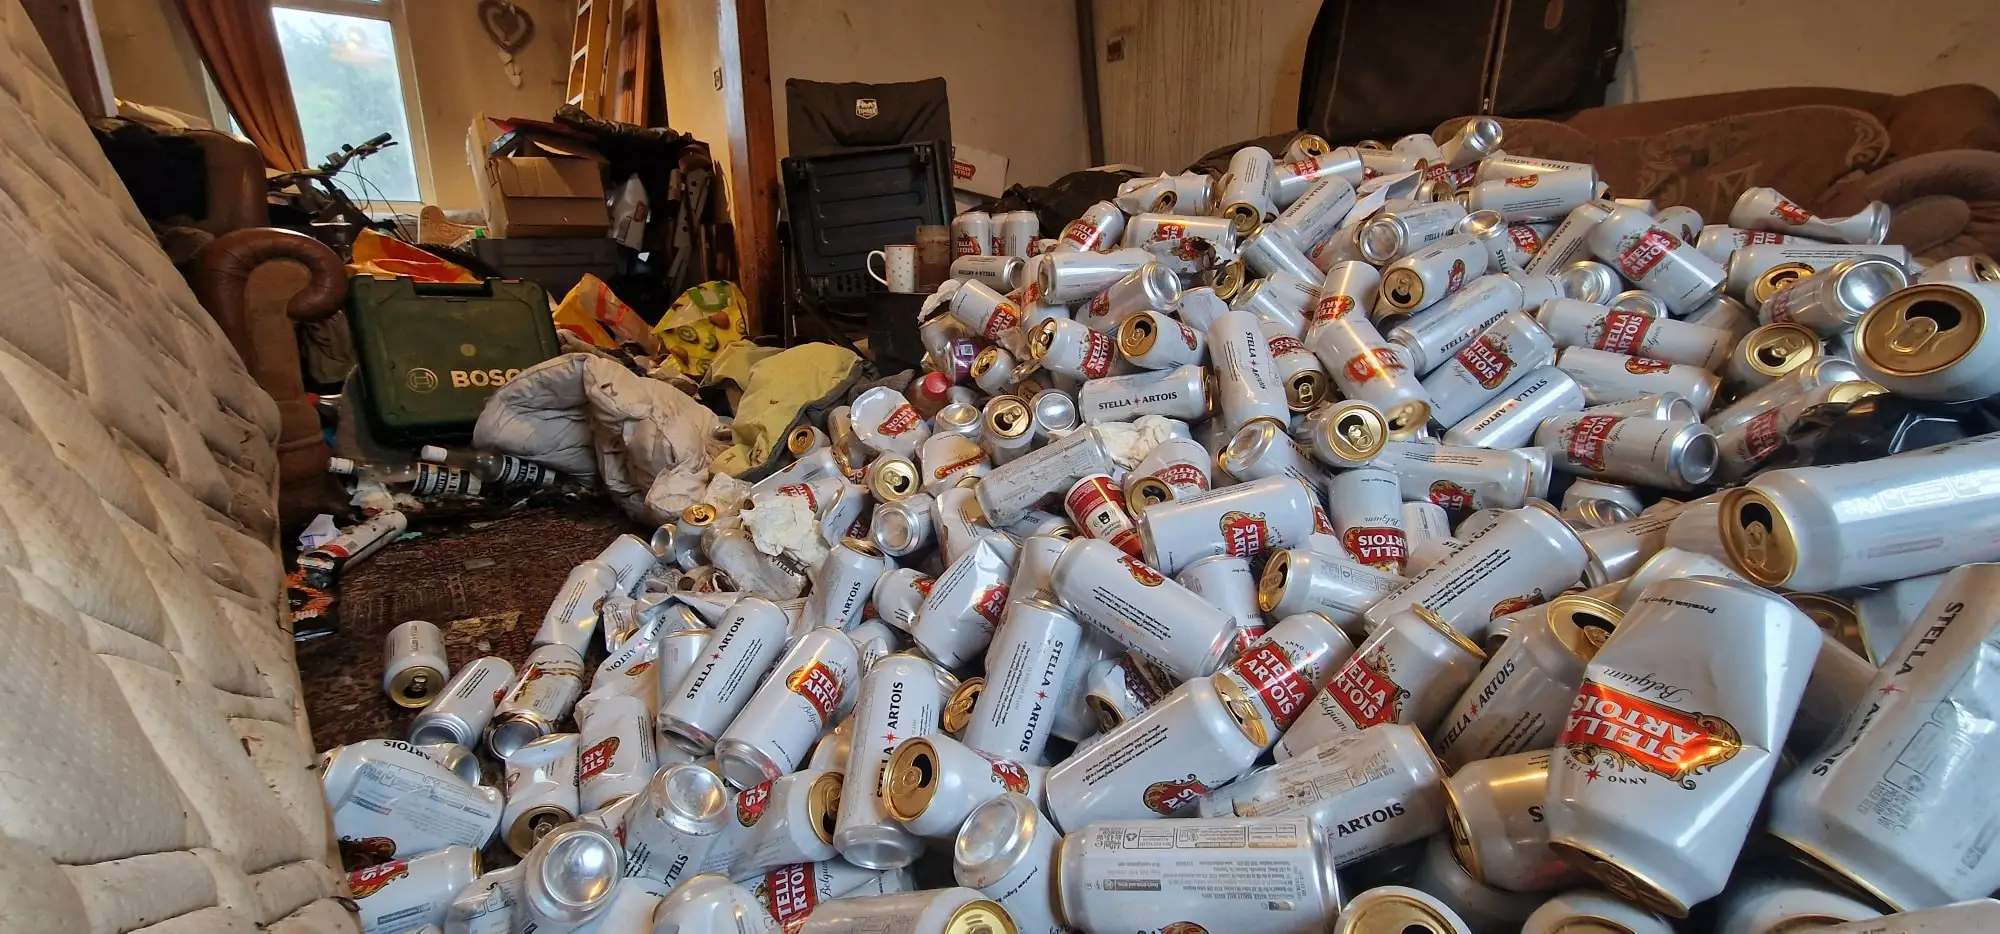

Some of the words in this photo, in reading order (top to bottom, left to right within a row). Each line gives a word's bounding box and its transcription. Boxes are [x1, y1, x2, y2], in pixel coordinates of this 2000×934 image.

[1623, 234, 1662, 267] STELLA
[1631, 238, 1671, 274] ARTOIS
[1088, 332, 1102, 370] STELLA
[1245, 331, 1257, 358] STELLA
[1440, 333, 1470, 354] STELLA
[1603, 313, 1631, 352] STELLA
[1617, 316, 1643, 355] ARTOIS
[1095, 334, 1110, 373] ARTOIS
[1462, 348, 1497, 379] ARTOIS
[1471, 340, 1504, 373] STELLA
[450, 368, 521, 388] BOSC
[1514, 378, 1548, 402] STELLA
[1099, 399, 1132, 410] STELLA
[1142, 391, 1178, 404] ARTOIS
[1474, 408, 1508, 432] ARTOIS
[1573, 416, 1600, 458] STELLA
[1584, 416, 1613, 459] ARTOIS
[1363, 514, 1400, 527] Belgium
[842, 581, 861, 616] ARTOIS
[1673, 598, 1717, 614] Premium
[1285, 640, 1305, 651] ANNO
[1895, 602, 1964, 676] STELLA
[605, 650, 636, 673] ARTOIS
[686, 662, 715, 700] STELLA
[719, 616, 745, 652] ARTOIS
[1042, 639, 1063, 687] STELLA
[1244, 658, 1295, 715] ARTOIS
[1257, 649, 1305, 706] STELLA
[1603, 667, 1693, 704] Belgium
[887, 681, 904, 730] ARTOIS
[1320, 692, 1348, 732] Belgium
[1440, 713, 1472, 754] STELLA
[1479, 659, 1516, 708] ARTOIS
[1571, 694, 1701, 745] ARTOIS
[1020, 702, 1042, 753] ARTOIS
[1566, 715, 1687, 764] STELLA
[384, 740, 431, 761] ARTOIS
[1562, 755, 1581, 772] 1366
[1608, 775, 1647, 785] ANNO
[1337, 802, 1405, 838] ARTOIS
[776, 866, 790, 920] TELLA
[791, 862, 809, 912] RTOIS
